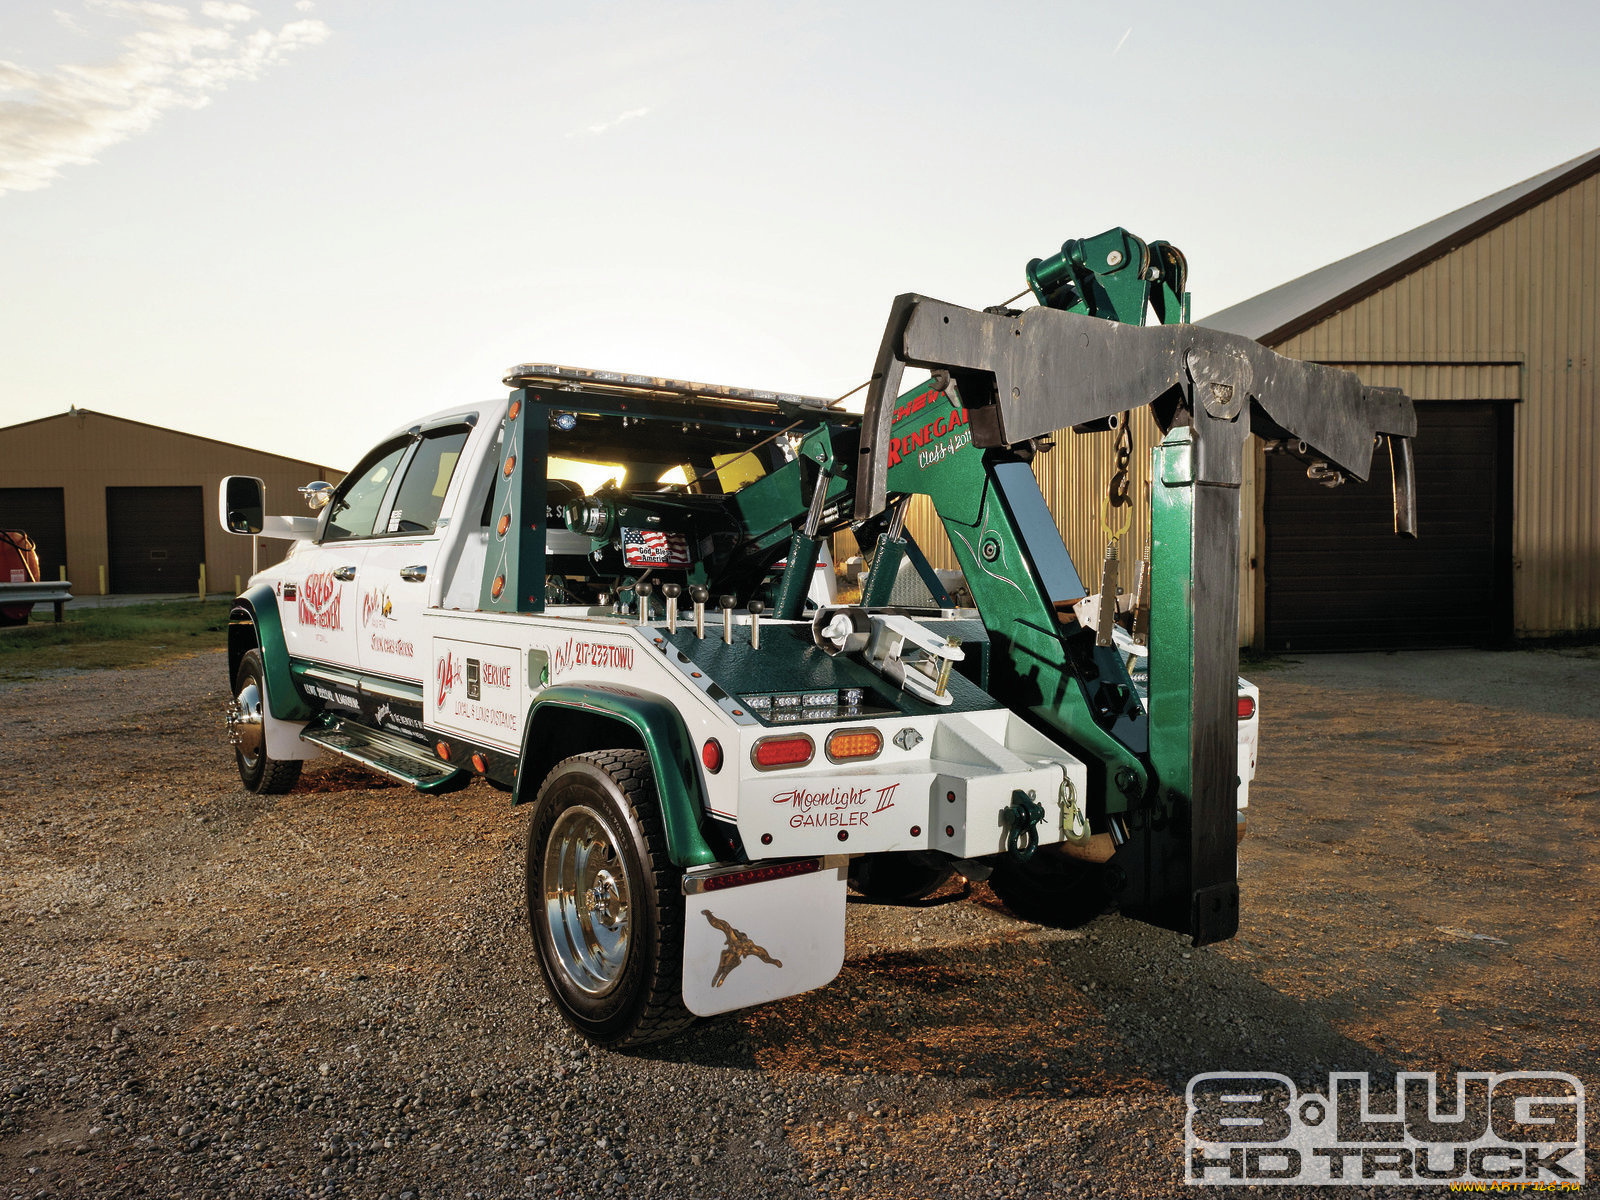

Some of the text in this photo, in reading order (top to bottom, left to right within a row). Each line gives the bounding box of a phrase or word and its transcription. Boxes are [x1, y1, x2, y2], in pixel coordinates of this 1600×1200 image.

[947, 438, 955, 455] of
[437, 651, 453, 709] 24
[482, 663, 511, 688] SERVICE
[455, 700, 471, 718] LOCAL
[476, 705, 489, 722] LONG
[489, 708, 517, 731] DISTANCE
[772, 787, 872, 813] Moonlight
[789, 811, 869, 829] GAMBLER
